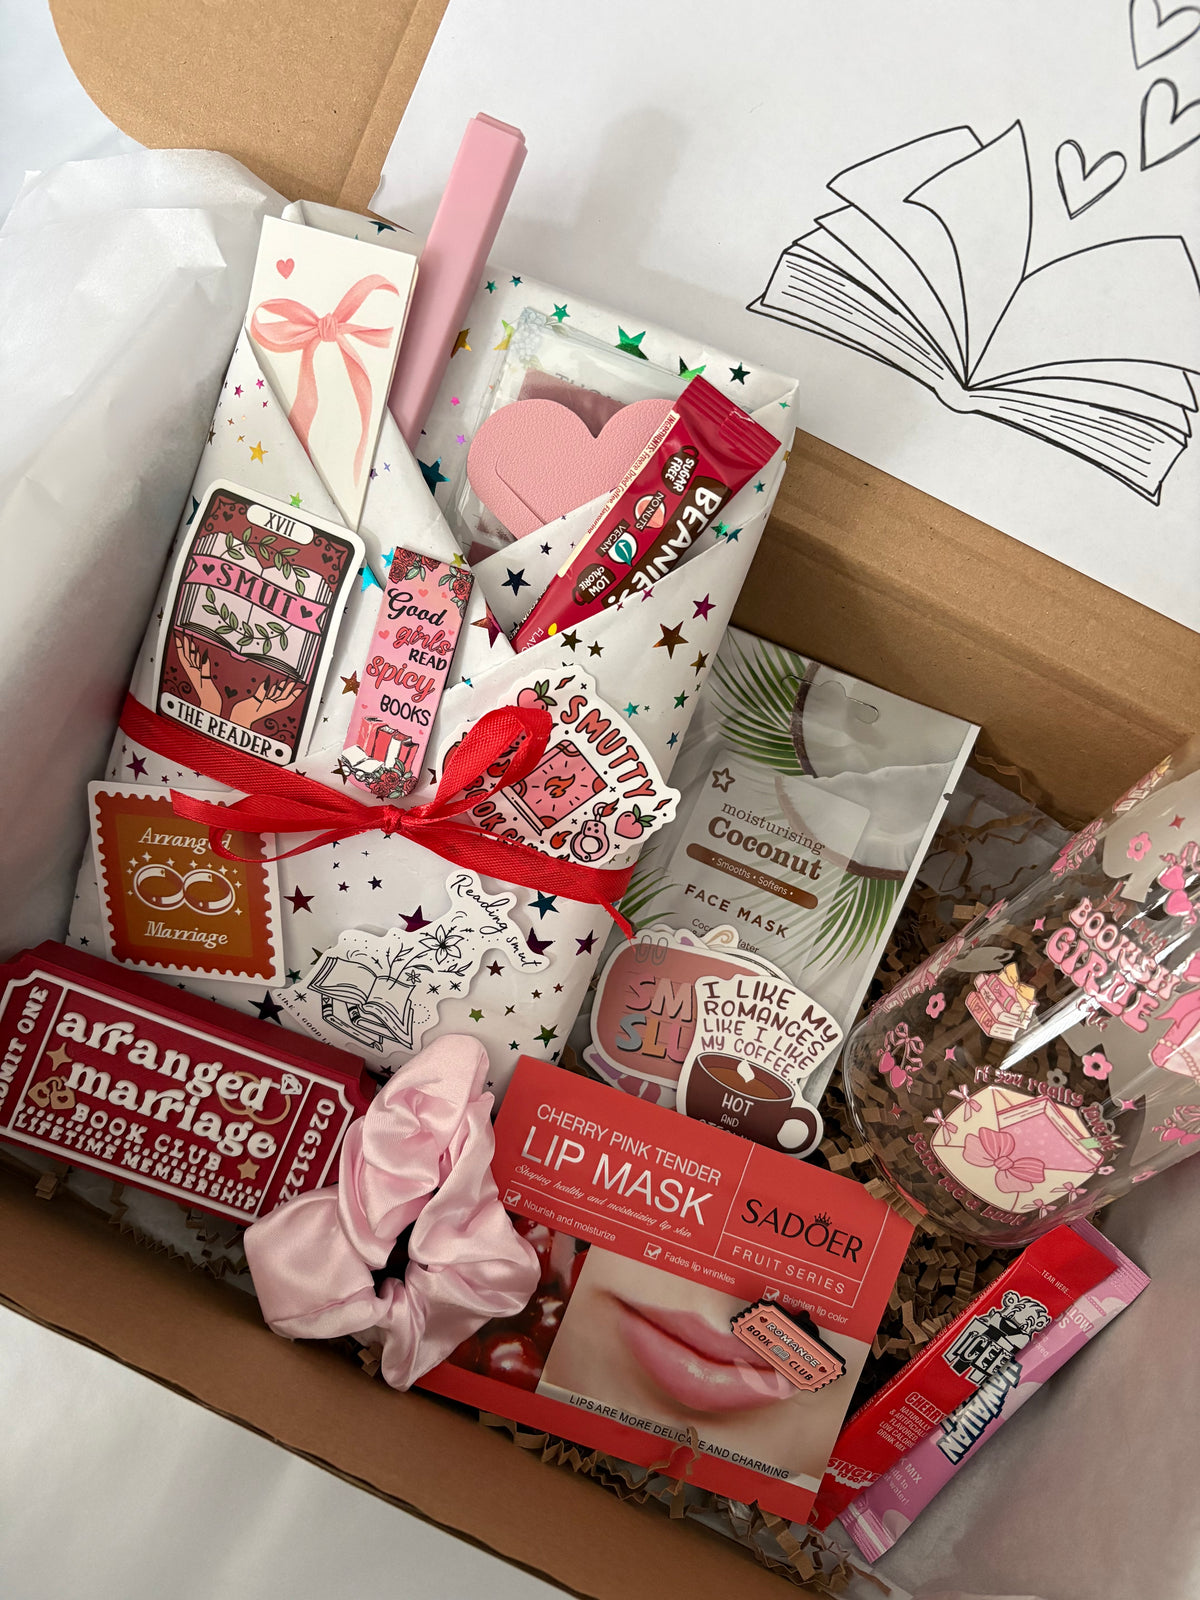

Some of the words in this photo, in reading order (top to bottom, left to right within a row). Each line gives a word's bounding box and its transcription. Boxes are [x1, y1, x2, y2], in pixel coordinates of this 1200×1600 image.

[622, 470, 637, 487] Dried
[634, 451, 650, 470] Freeze
[665, 457, 683, 482] FREE
[672, 457, 695, 494] SUGAR
[636, 506, 654, 530] NUTS
[652, 492, 664, 507] NO
[264, 512, 297, 537] XVII
[600, 525, 628, 552] VEGAN
[216, 563, 298, 619] SMUT
[579, 566, 605, 591] CALORIE
[588, 575, 610, 597] LOW
[387, 587, 448, 627] Good
[393, 625, 455, 656] girls
[408, 648, 447, 671] READ
[366, 655, 435, 703] spicy
[176, 701, 204, 729] THE
[207, 720, 272, 758] READER
[379, 694, 432, 727] BOOKS
[560, 694, 657, 798] SMUTTY
[139, 827, 232, 854] Arrangd
[708, 816, 823, 881] Coconut
[721, 802, 826, 856] moisturising
[716, 857, 751, 879] Smooths
[758, 875, 788, 895] Softens
[450, 874, 511, 935] Reading
[506, 936, 542, 968] smut
[684, 883, 731, 912] FACE
[737, 907, 791, 939] MASK
[144, 920, 228, 949] Marriage
[1069, 897, 1181, 1000] BOOKISH
[1046, 927, 1159, 1033] GIRLIE
[17, 985, 49, 1034] ONE
[702, 981, 720, 999] I
[736, 980, 796, 1010] LIKE
[801, 1005, 839, 1044] MY
[704, 1000, 825, 1057] ROMANCES
[56, 1011, 273, 1111] arranged
[701, 1035, 725, 1051] MY
[703, 1018, 745, 1036] LIKE
[756, 1026, 768, 1044] I
[774, 1036, 815, 1070] LIKE
[64, 1061, 277, 1159] marriage
[721, 1092, 754, 1116] HOT
[1028, 1078, 1083, 1107] really
[71, 1103, 148, 1145] BOOK
[154, 1134, 222, 1171] CLUB
[720, 1114, 739, 1127] AND
[15, 1111, 117, 1160] LIFETIME
[121, 1150, 257, 1211] MEMBERSHIP
[273, 1098, 336, 1211] 0263122
[537, 1103, 609, 1142] CHERRY
[609, 1131, 654, 1161] PINK
[655, 1147, 722, 1187] TENDER
[520, 1125, 586, 1172] LIP
[592, 1153, 714, 1226] MASK
[908, 1132, 943, 1176] send
[981, 1207, 1027, 1226] book
[514, 1164, 552, 1186] Shaping
[553, 1180, 585, 1199] healthy
[587, 1193, 608, 1207] and
[607, 1202, 658, 1226] moisturizing
[659, 1216, 672, 1231] lip
[673, 1223, 692, 1239] skin
[523, 1199, 555, 1219] Nourish
[556, 1210, 573, 1226] and
[574, 1216, 616, 1241] moisturize
[740, 1199, 863, 1263] SADOER
[664, 1251, 690, 1268] Fades
[691, 1260, 701, 1273] lip
[702, 1263, 736, 1285] wrinkles
[732, 1245, 782, 1271] FRUIT
[785, 1264, 846, 1295] SERIES
[1041, 1269, 1055, 1286] TEAR
[782, 1294, 815, 1313] Brighten
[816, 1304, 827, 1317] lip
[827, 1308, 848, 1324] color
[746, 1324, 773, 1347] BOOK
[788, 1360, 814, 1381] CLUB
[765, 1321, 821, 1368] ROMANCE
[950, 1330, 1014, 1375] ICEE
[880, 1421, 891, 1431] LOW
[900, 1406, 932, 1431] NATURALLY
[905, 1391, 948, 1425] CHERRY
[936, 1360, 1024, 1466] HAWAIIAN
[569, 1394, 595, 1410] LIPS
[594, 1403, 617, 1419] ARE
[618, 1411, 652, 1430] MORE
[653, 1424, 706, 1450] DELICAE
[706, 1444, 730, 1459] AND
[731, 1452, 790, 1480] CHARMING
[877, 1429, 895, 1444] DRINK
[894, 1441, 907, 1452] MIX
[905, 1463, 922, 1484] MIX
